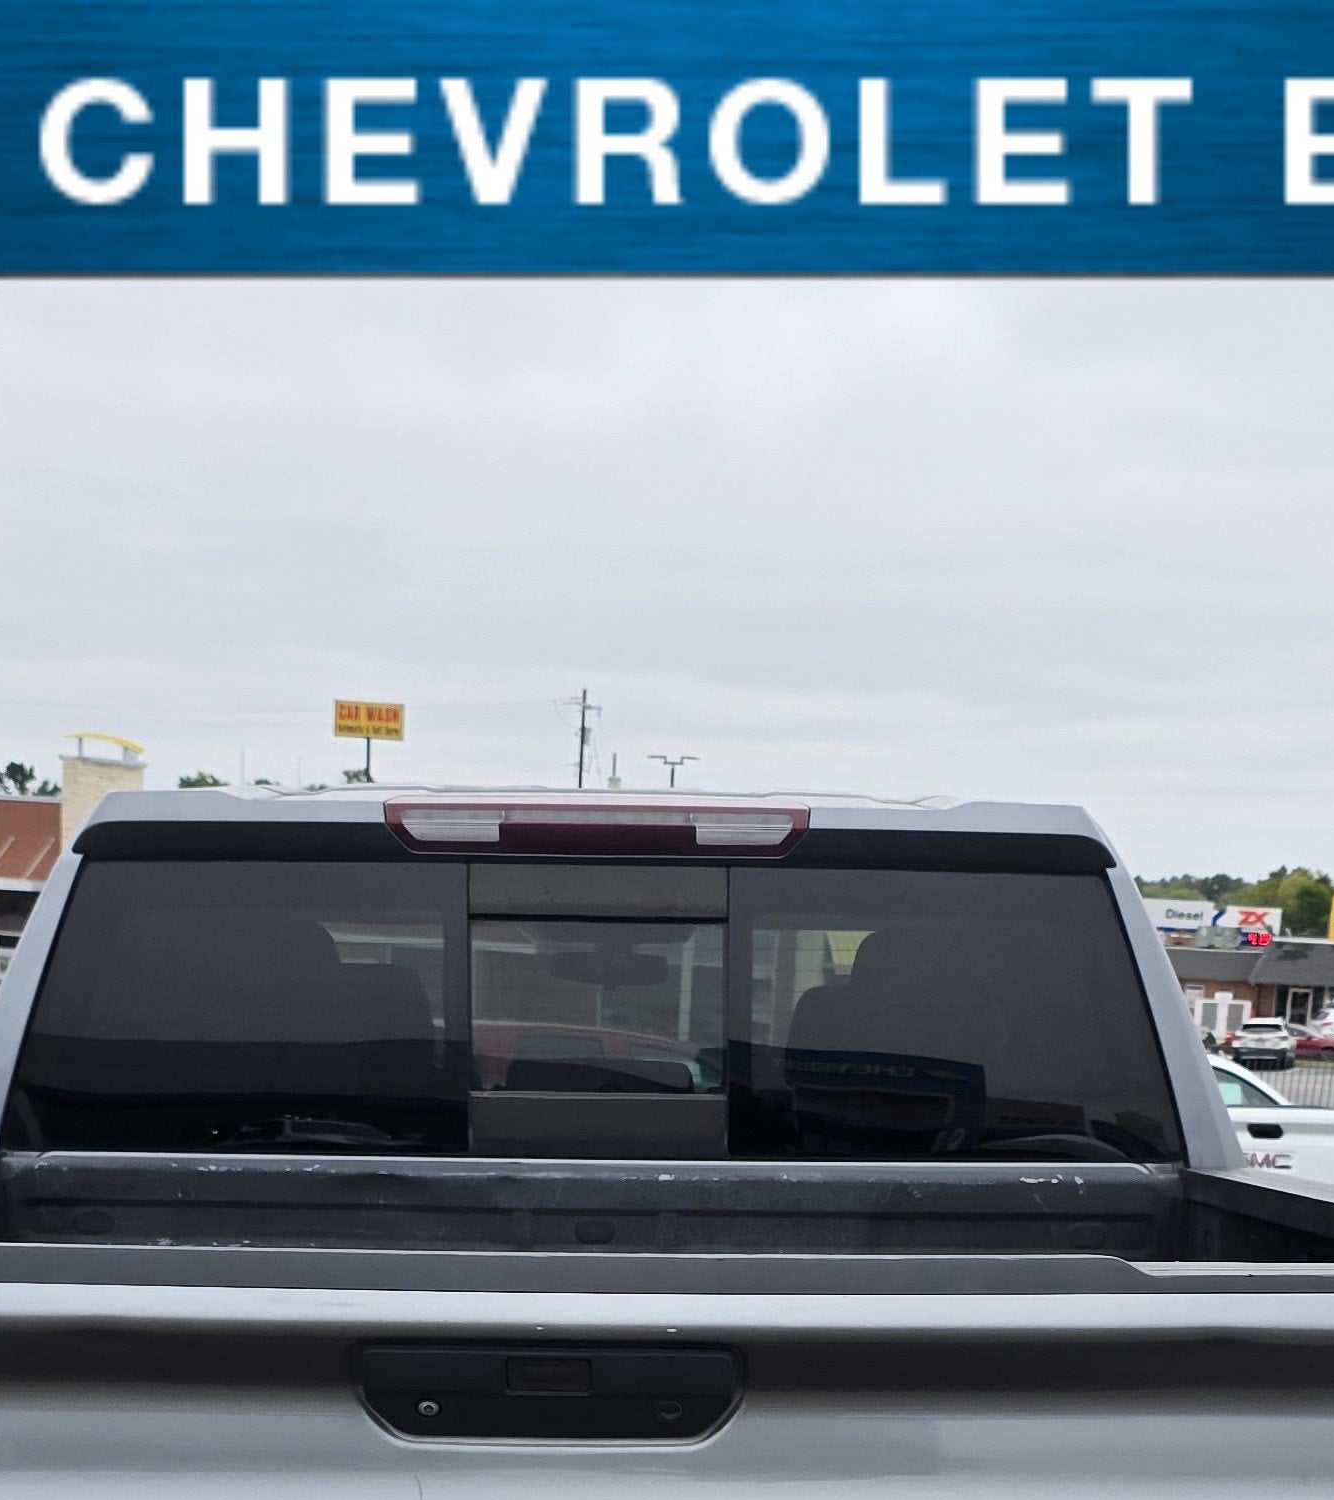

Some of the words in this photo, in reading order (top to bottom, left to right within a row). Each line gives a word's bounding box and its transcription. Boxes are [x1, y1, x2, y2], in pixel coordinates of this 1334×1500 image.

[338, 704, 361, 721] CAR
[366, 706, 400, 723] WASH
[1165, 908, 1204, 921] Diesel
[1246, 1153, 1292, 1170] MC
